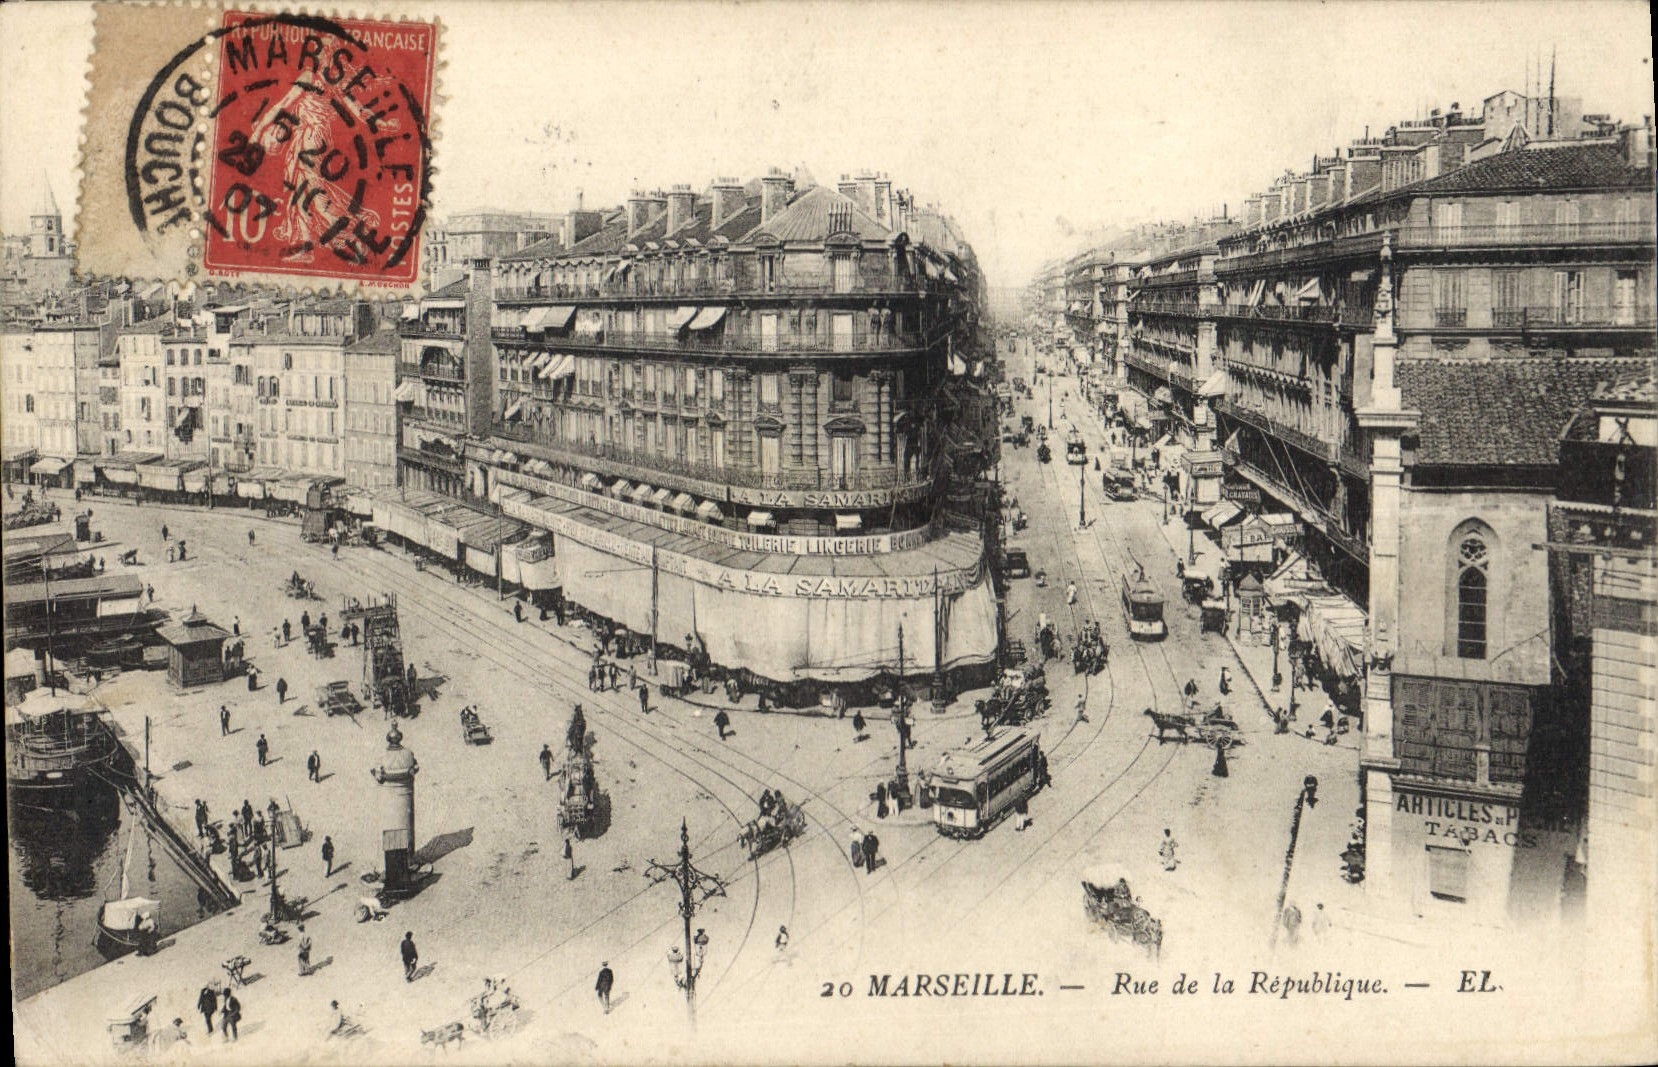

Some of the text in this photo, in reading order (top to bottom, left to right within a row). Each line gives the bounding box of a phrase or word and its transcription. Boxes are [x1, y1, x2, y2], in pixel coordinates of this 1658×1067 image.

[389, 183, 414, 266] OSTES
[1396, 794, 1494, 826] ARTICLES
[1425, 820, 1538, 849] TABACS
